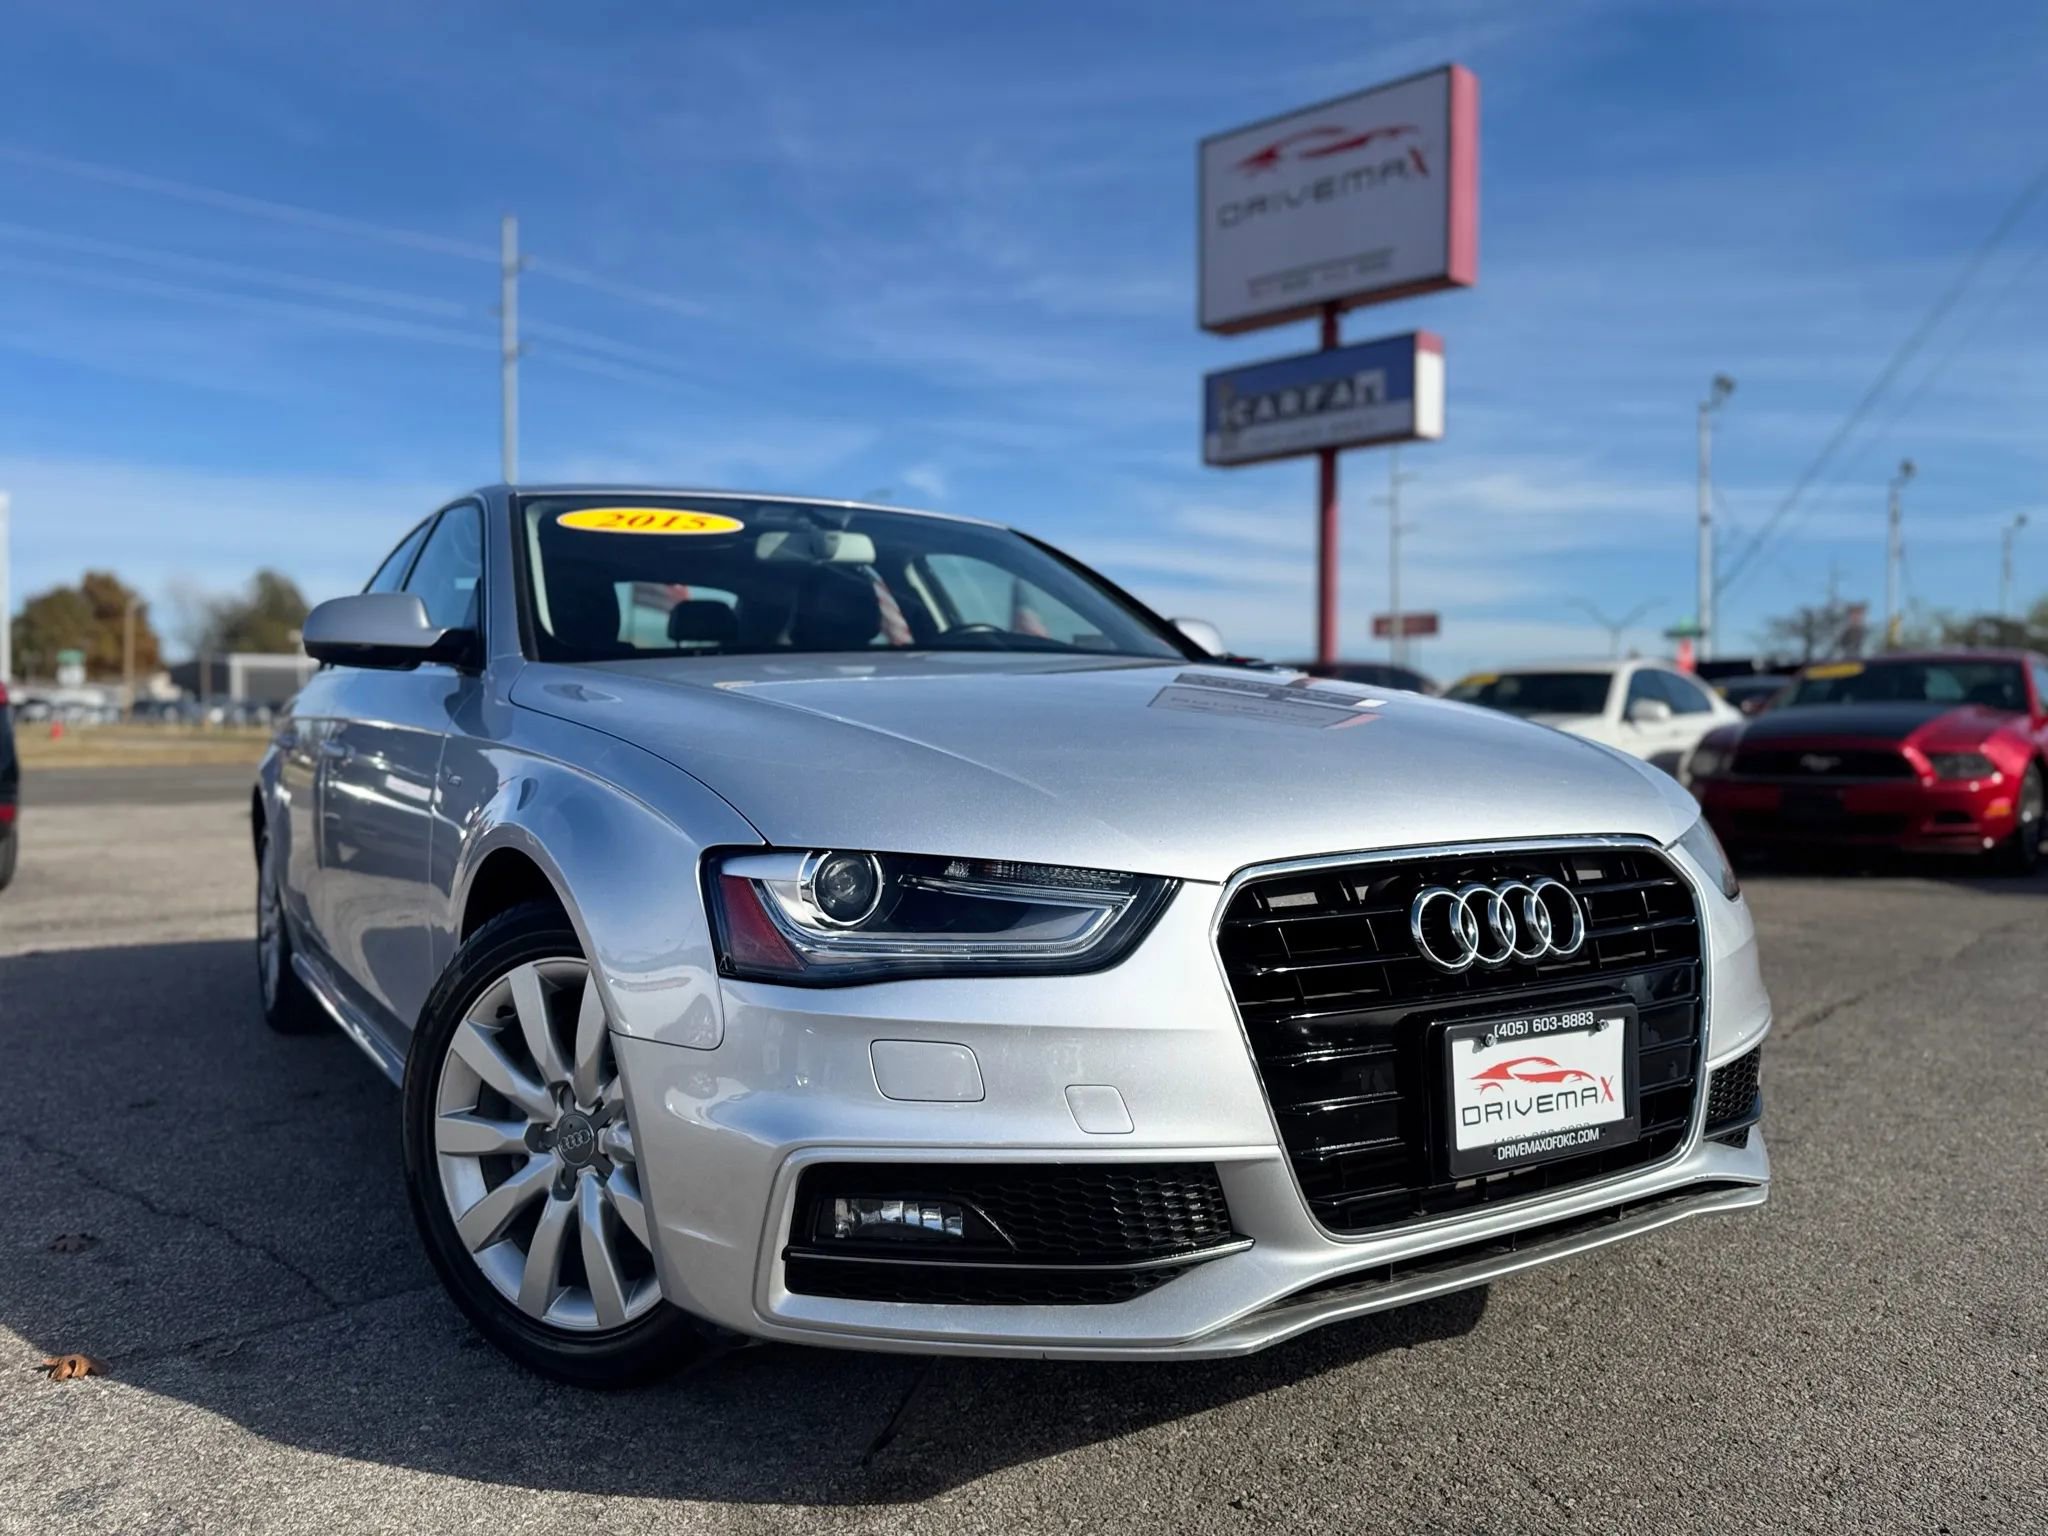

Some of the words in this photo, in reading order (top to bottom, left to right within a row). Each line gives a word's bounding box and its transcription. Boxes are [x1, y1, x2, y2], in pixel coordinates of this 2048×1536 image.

[1217, 144, 1431, 229] DRIVEMAX
[596, 513, 712, 529] 2015
[1494, 1021, 1529, 1038] (405)
[1533, 1011, 1594, 1032] 603-8883
[1462, 1075, 1614, 1126] DRIVEMAX
[1497, 1128, 1600, 1160] DRIVEMAXOFOKC.COM
